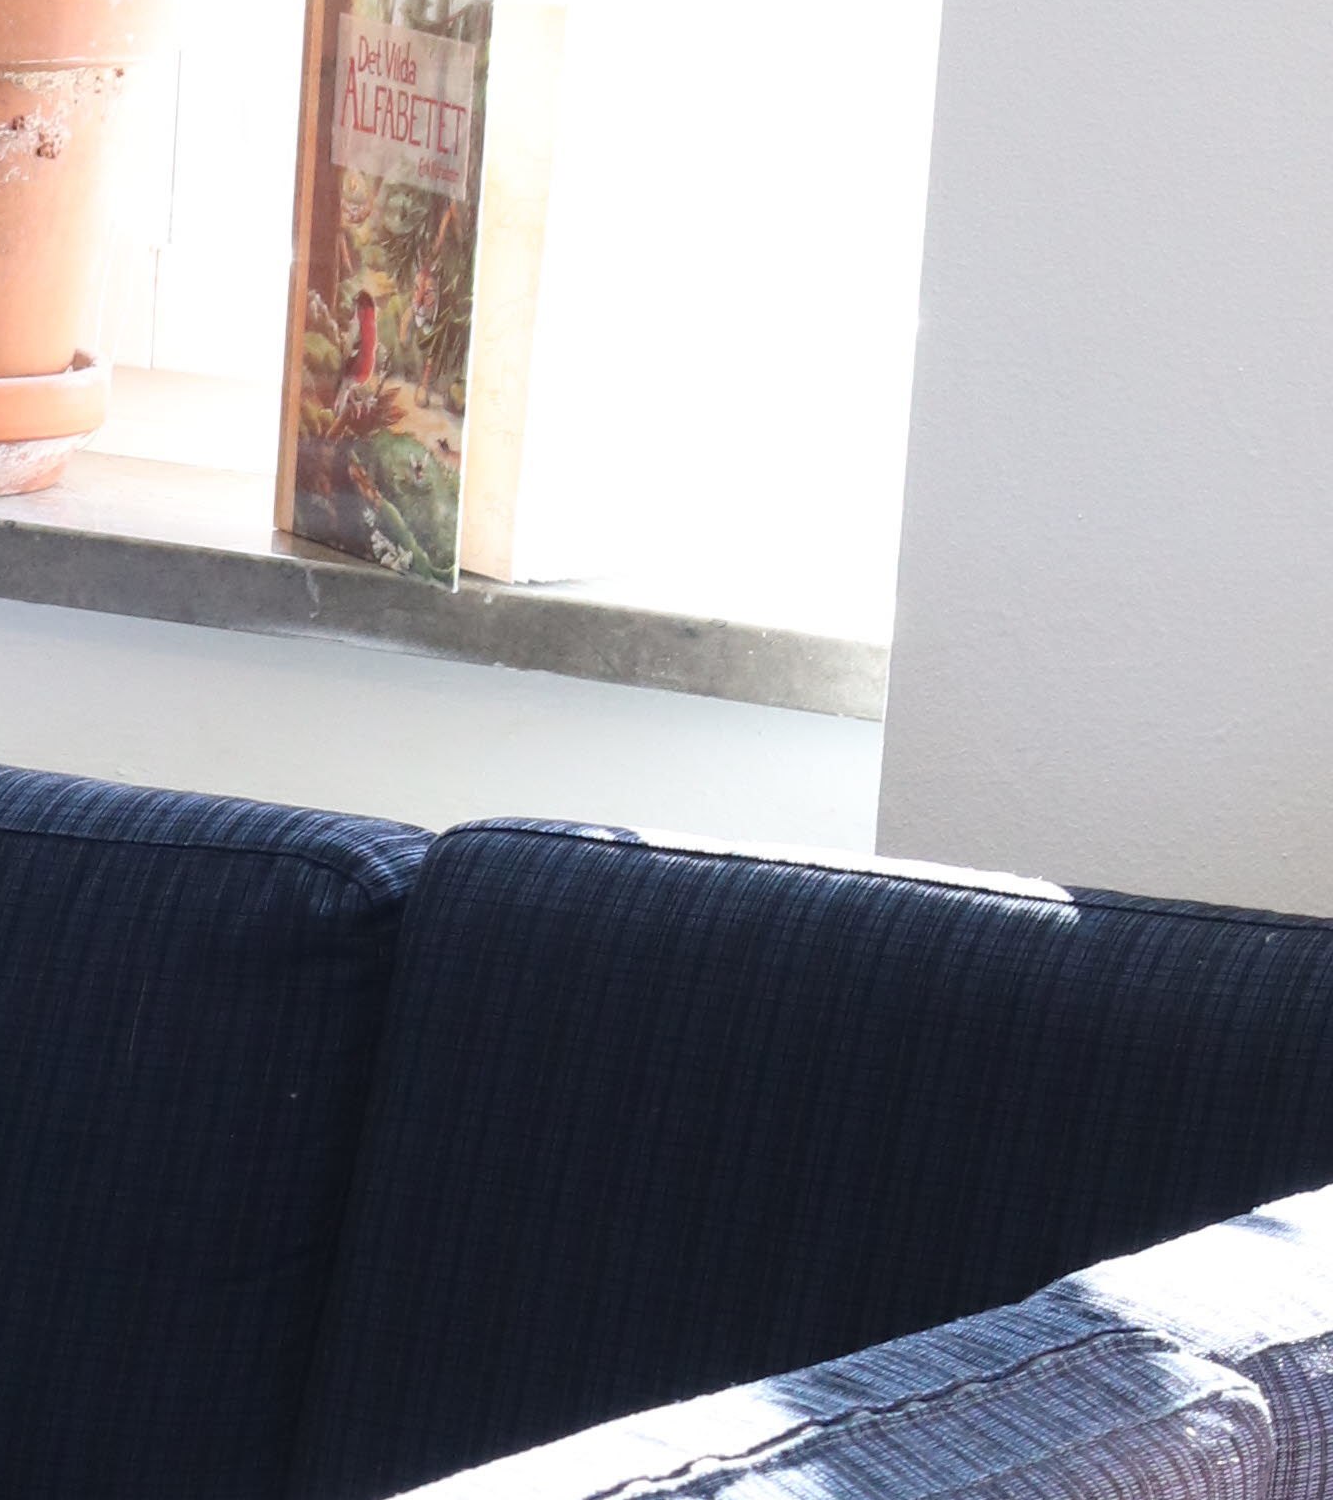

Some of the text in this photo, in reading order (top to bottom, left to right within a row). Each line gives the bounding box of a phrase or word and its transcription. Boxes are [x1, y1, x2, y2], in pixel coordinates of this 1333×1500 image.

[358, 36, 417, 86] Det Vilda
[341, 57, 467, 157] ALFABETET
